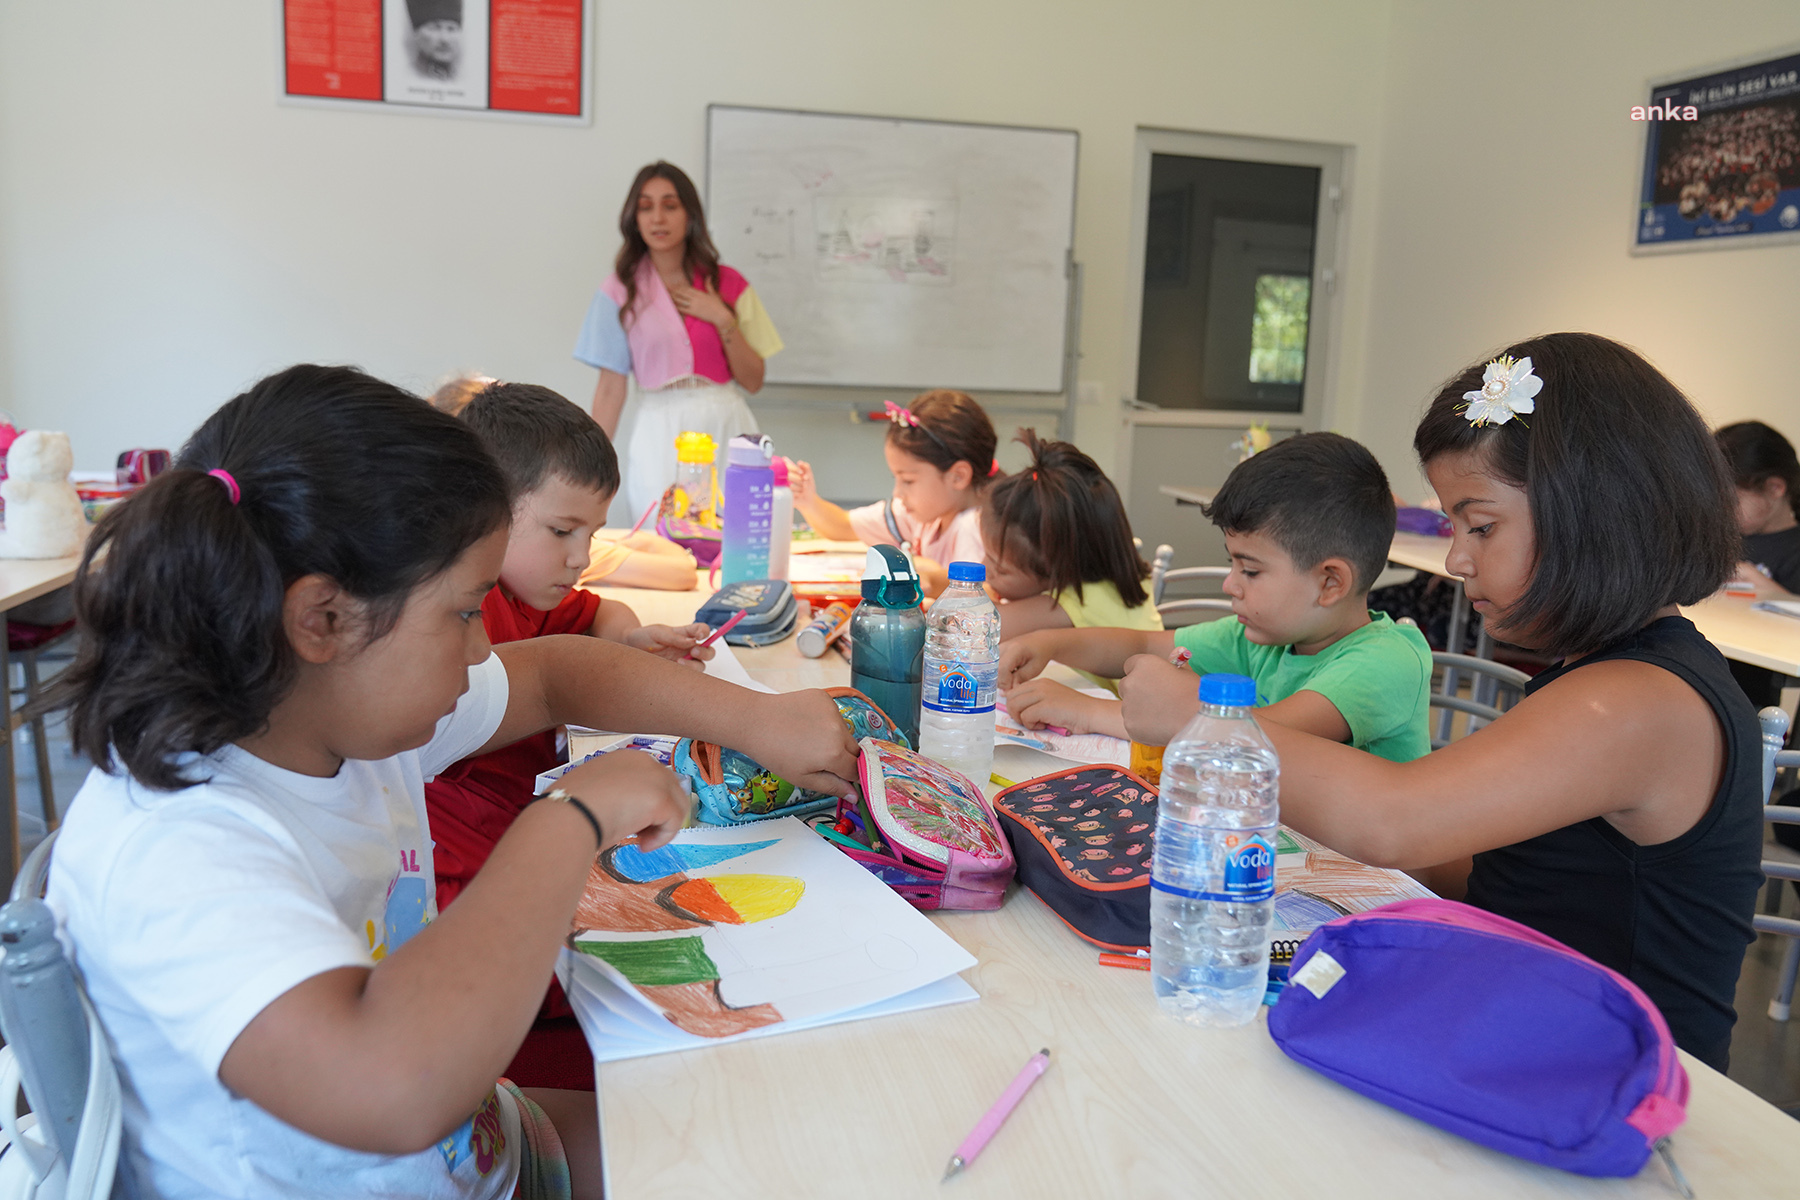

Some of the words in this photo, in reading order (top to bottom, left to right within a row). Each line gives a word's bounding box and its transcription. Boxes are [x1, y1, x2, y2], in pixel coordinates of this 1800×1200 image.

[1768, 70, 1798, 89] VAR
[941, 677, 972, 689] voda
[960, 689, 975, 699] life
[1230, 849, 1270, 868] voda
